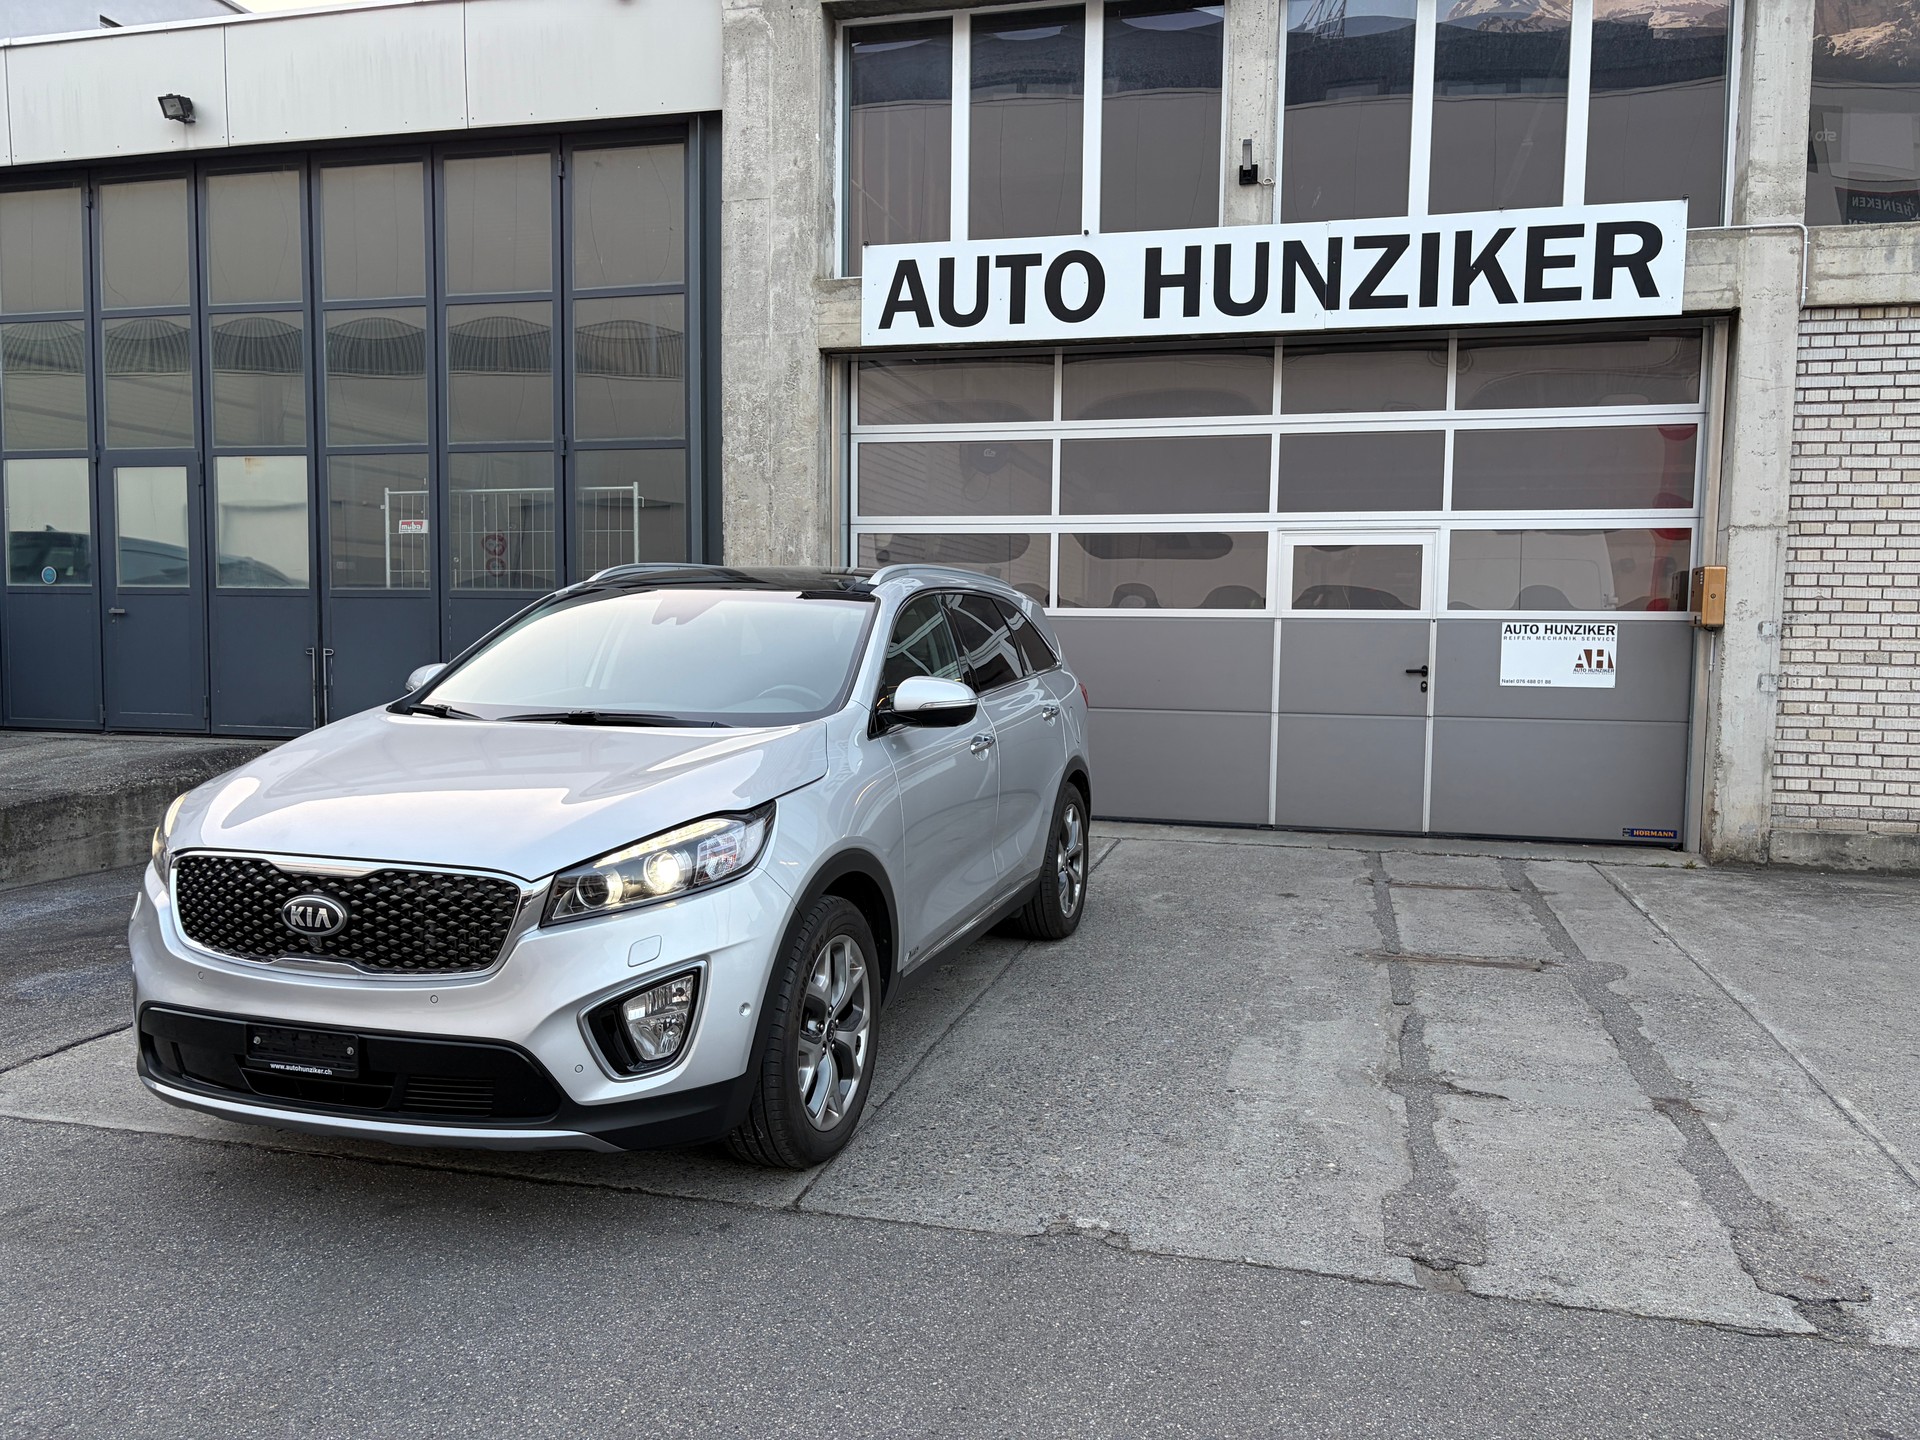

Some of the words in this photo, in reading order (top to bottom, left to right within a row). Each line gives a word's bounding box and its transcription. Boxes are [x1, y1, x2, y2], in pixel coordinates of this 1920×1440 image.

[878, 250, 1106, 329] AUTO
[1143, 220, 1663, 319] HUNZIKER
[1504, 624, 1539, 635] AUTO
[1544, 624, 1616, 636] HUNZIKER
[290, 905, 332, 929] KIA
[270, 1063, 333, 1076] www.autohunziker.ch
